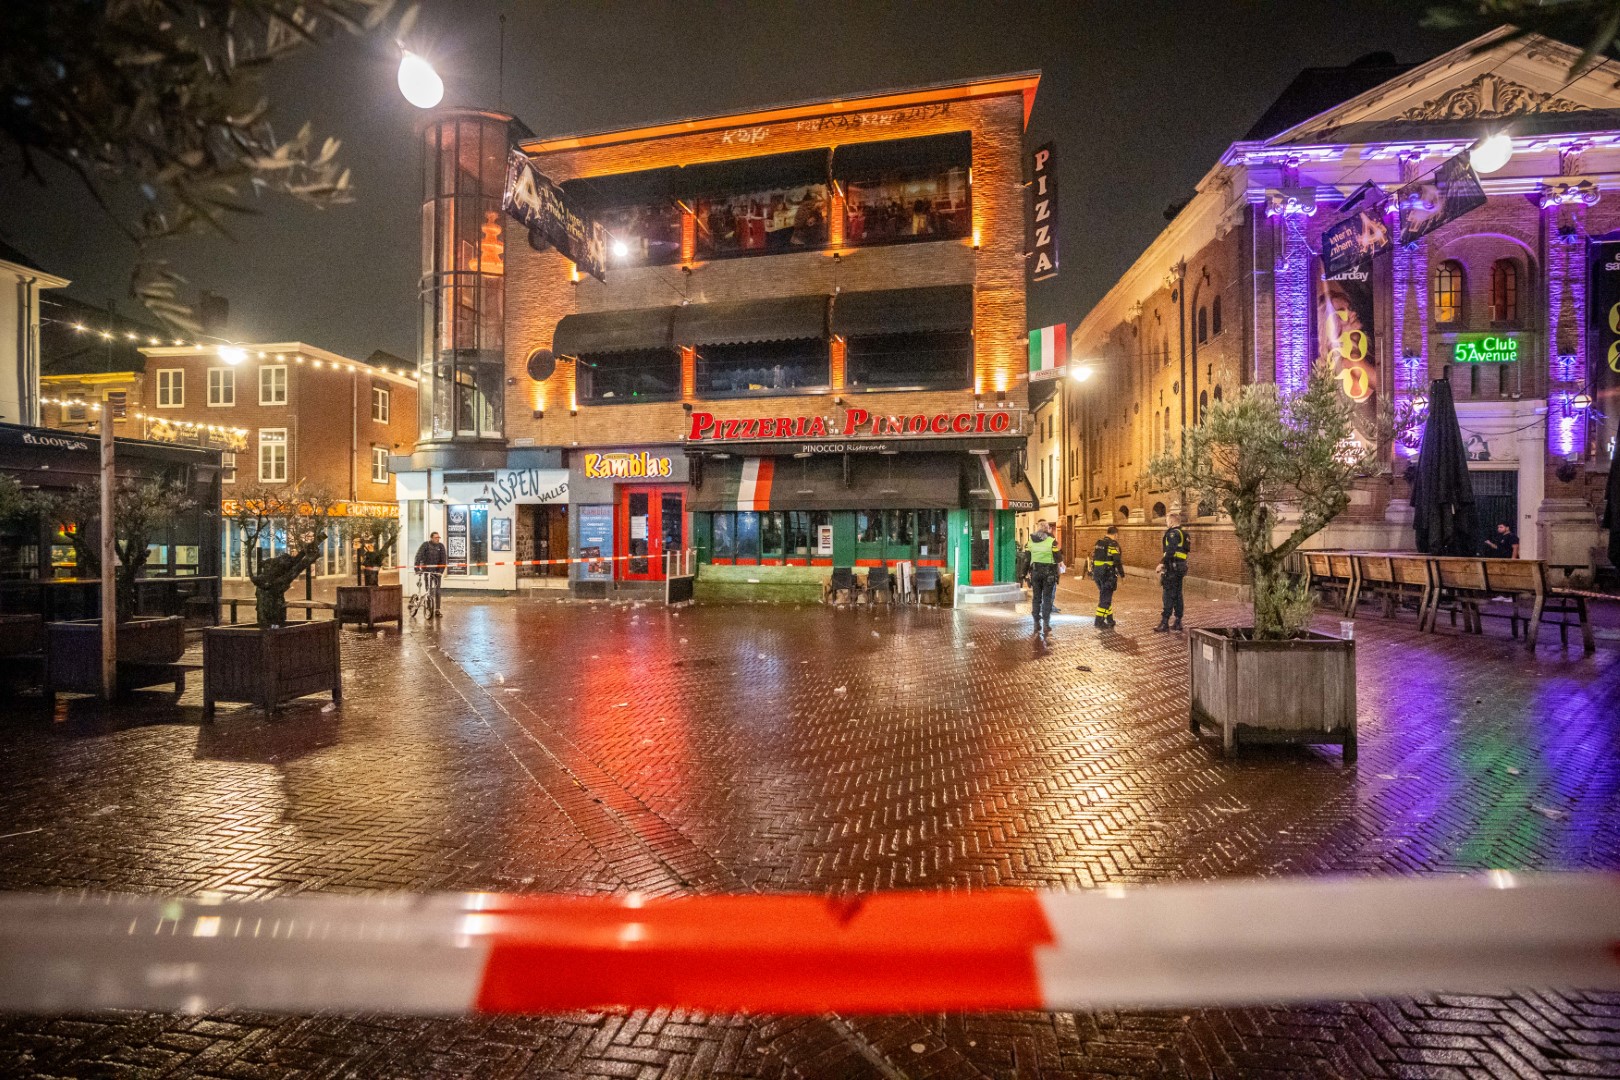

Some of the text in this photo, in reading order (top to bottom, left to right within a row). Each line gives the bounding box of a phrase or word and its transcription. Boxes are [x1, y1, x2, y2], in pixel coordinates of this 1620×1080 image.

[1034, 149, 1053, 274] PIZZA
[1483, 337, 1518, 351] Club
[1467, 347, 1518, 362] Avenue
[688, 408, 1010, 441] PIZZERIA PINOCCIO
[22, 433, 88, 450] BLOOPERS
[802, 443, 887, 453] PINOCCIO Ristorante
[491, 467, 539, 511] ASPEN
